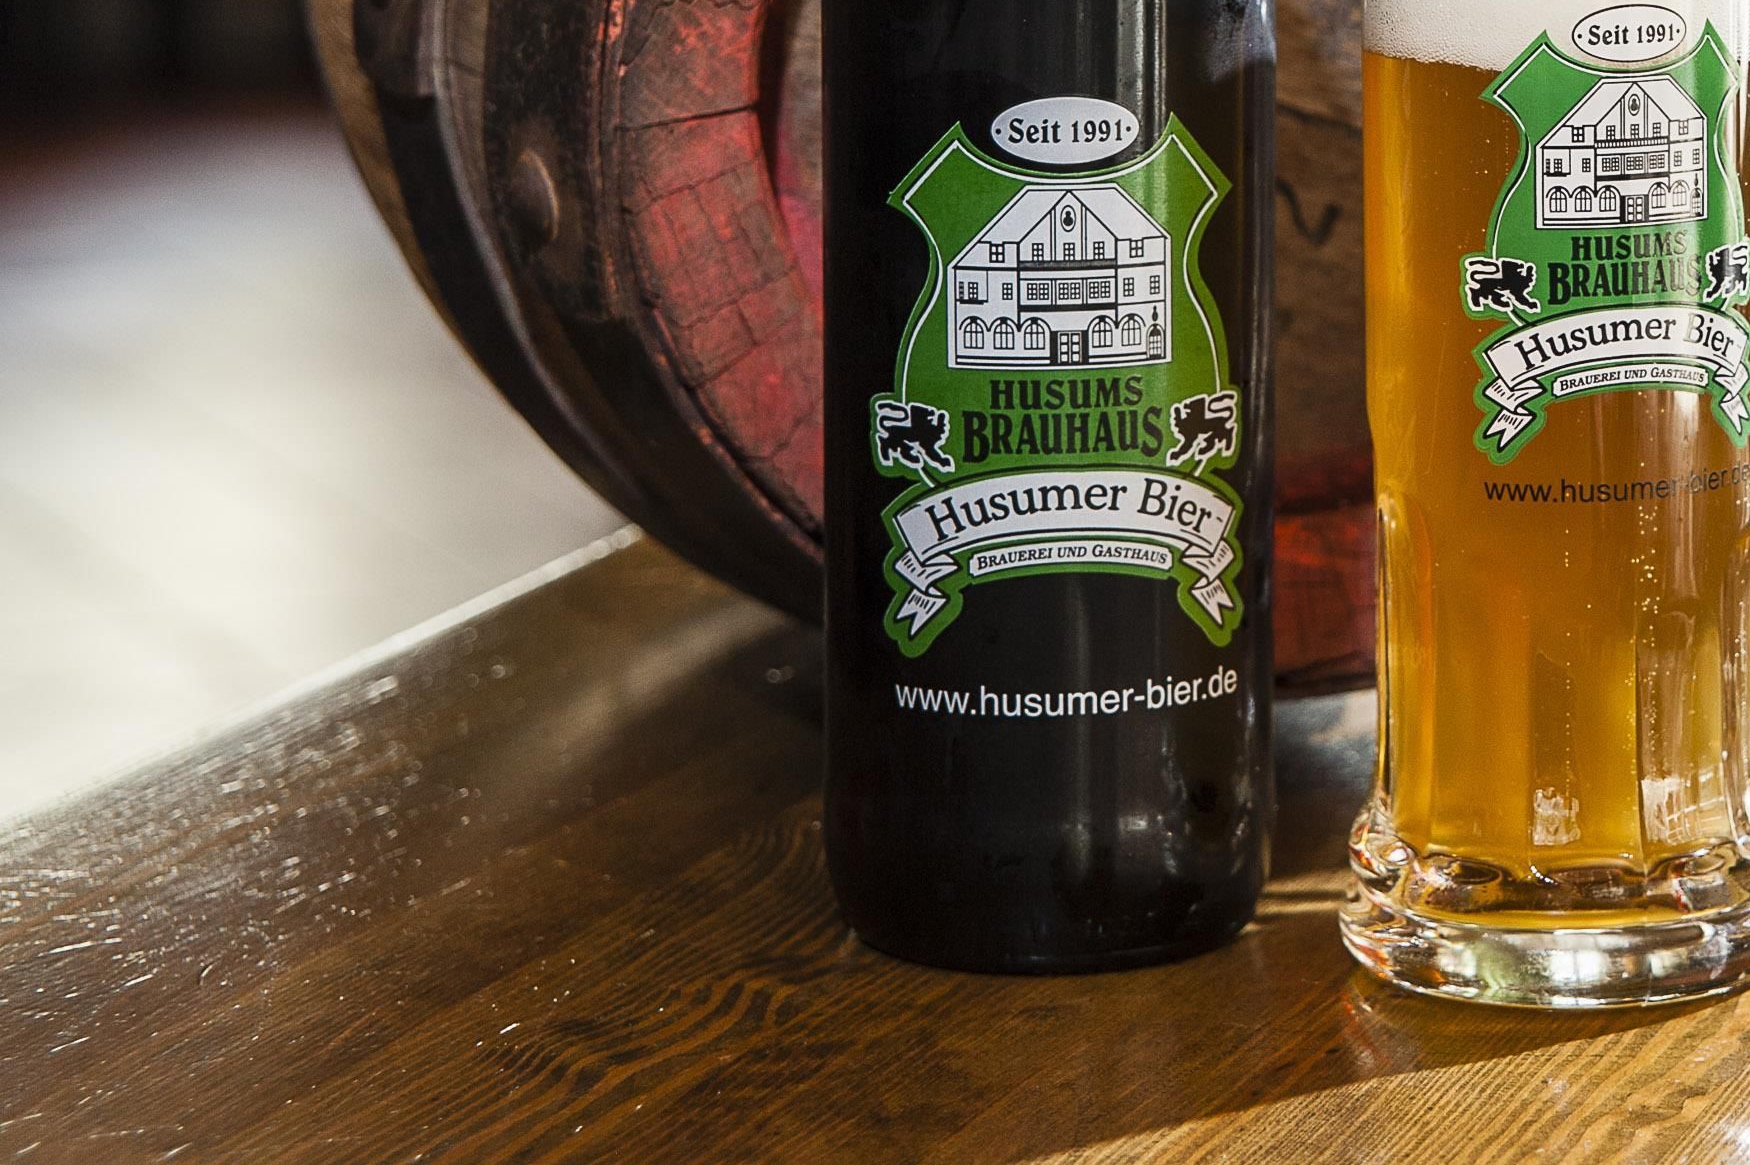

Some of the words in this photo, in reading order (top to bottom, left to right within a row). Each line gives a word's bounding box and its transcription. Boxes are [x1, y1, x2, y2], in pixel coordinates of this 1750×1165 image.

[1587, 23, 1629, 46] Seit
[1636, 23, 1675, 44] 1991
[1008, 118, 1061, 144] Seit
[1071, 118, 1123, 144] 1991
[1571, 230, 1688, 262] HUSUMS
[1547, 253, 1701, 306] BRAUHAUS
[1514, 317, 1676, 371] Husumer
[1683, 314, 1734, 358] Bier
[989, 376, 1144, 411] HUSUMS
[1559, 371, 1621, 392] BRAUEREI
[1624, 368, 1648, 380] UND
[1650, 366, 1705, 383] GASTHAUS
[962, 405, 1163, 464] BRAUHAUS
[1484, 460, 1750, 504] www.husumer-bierde
[924, 481, 1128, 542] Husumer
[1136, 478, 1214, 535] Bier
[977, 547, 1054, 571] BRAUEREI
[1057, 546, 1088, 560] UND
[1092, 544, 1168, 566] GASTHAUS
[896, 665, 1238, 718] www.husumer-bier.de
